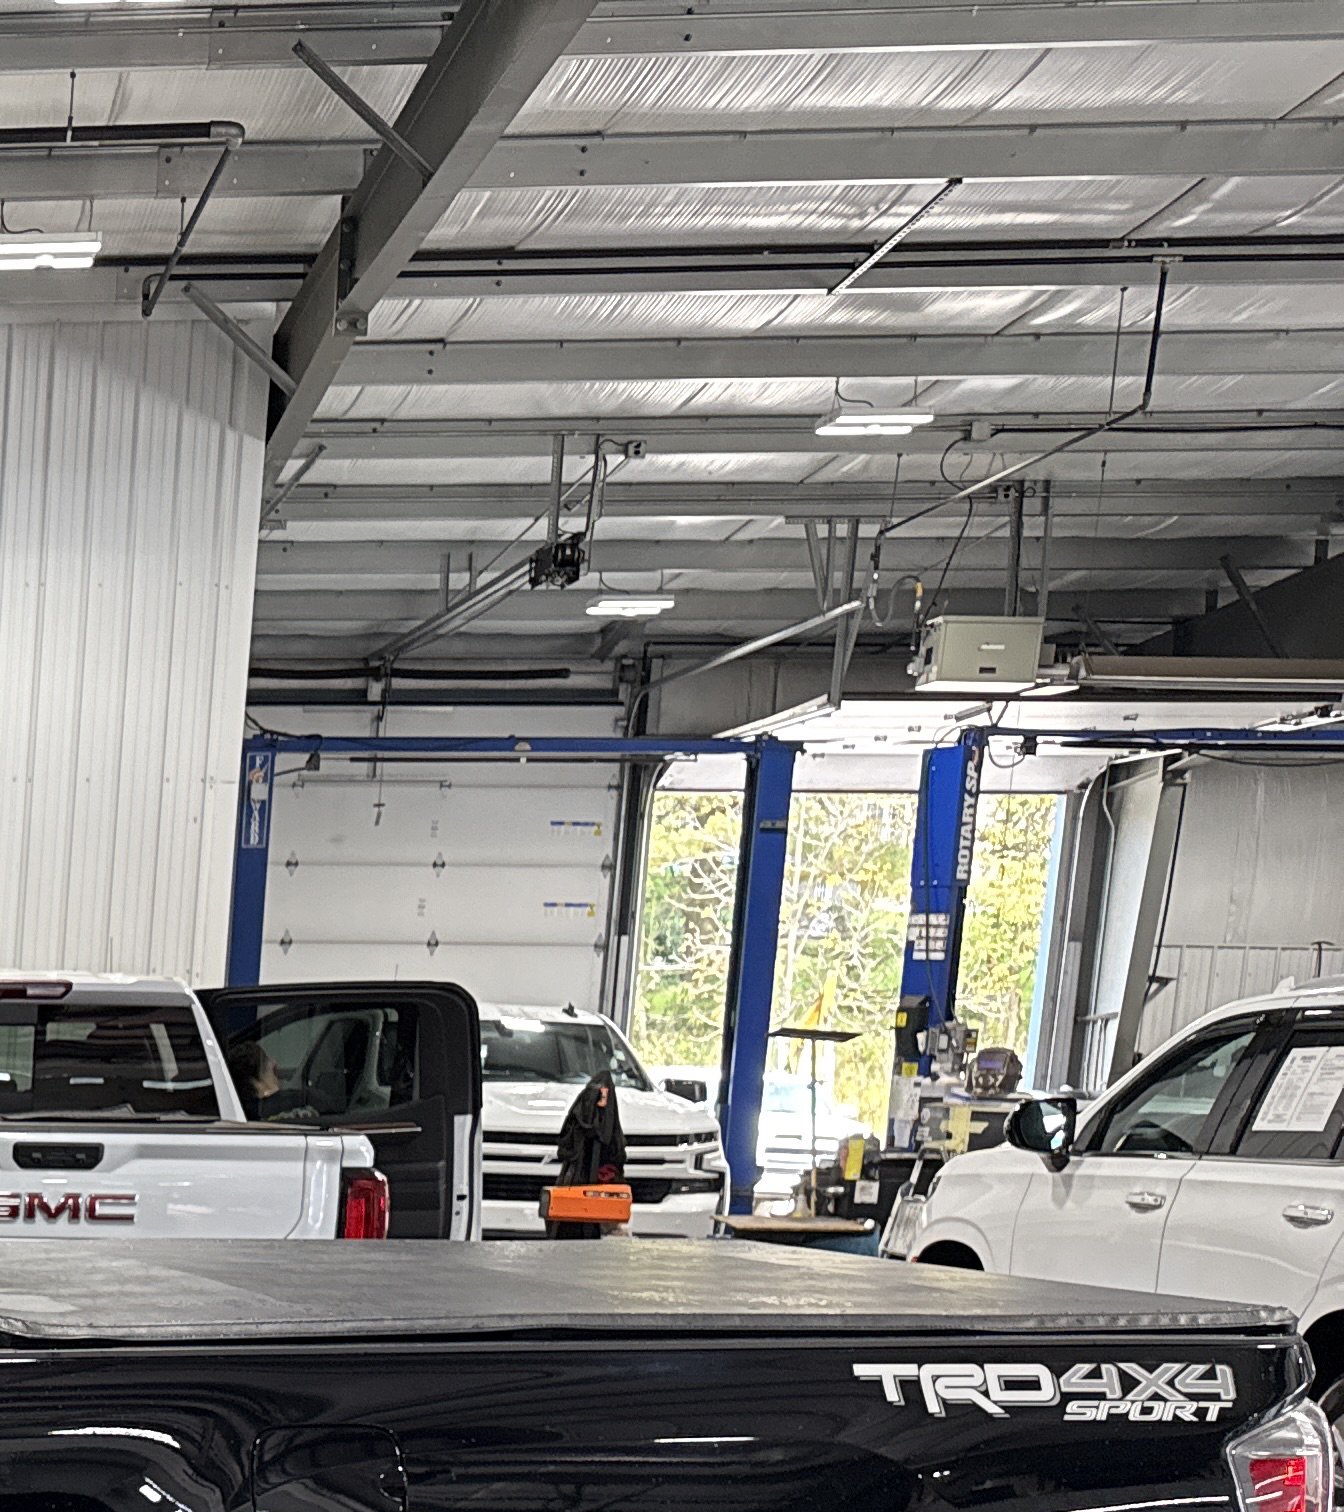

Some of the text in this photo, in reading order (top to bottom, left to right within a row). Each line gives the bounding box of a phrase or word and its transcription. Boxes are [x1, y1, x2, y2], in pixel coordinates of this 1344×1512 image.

[956, 793, 976, 881] ROTARY
[852, 1362, 1237, 1418] TRD 4X4
[1062, 1401, 1234, 1422] SPORT
